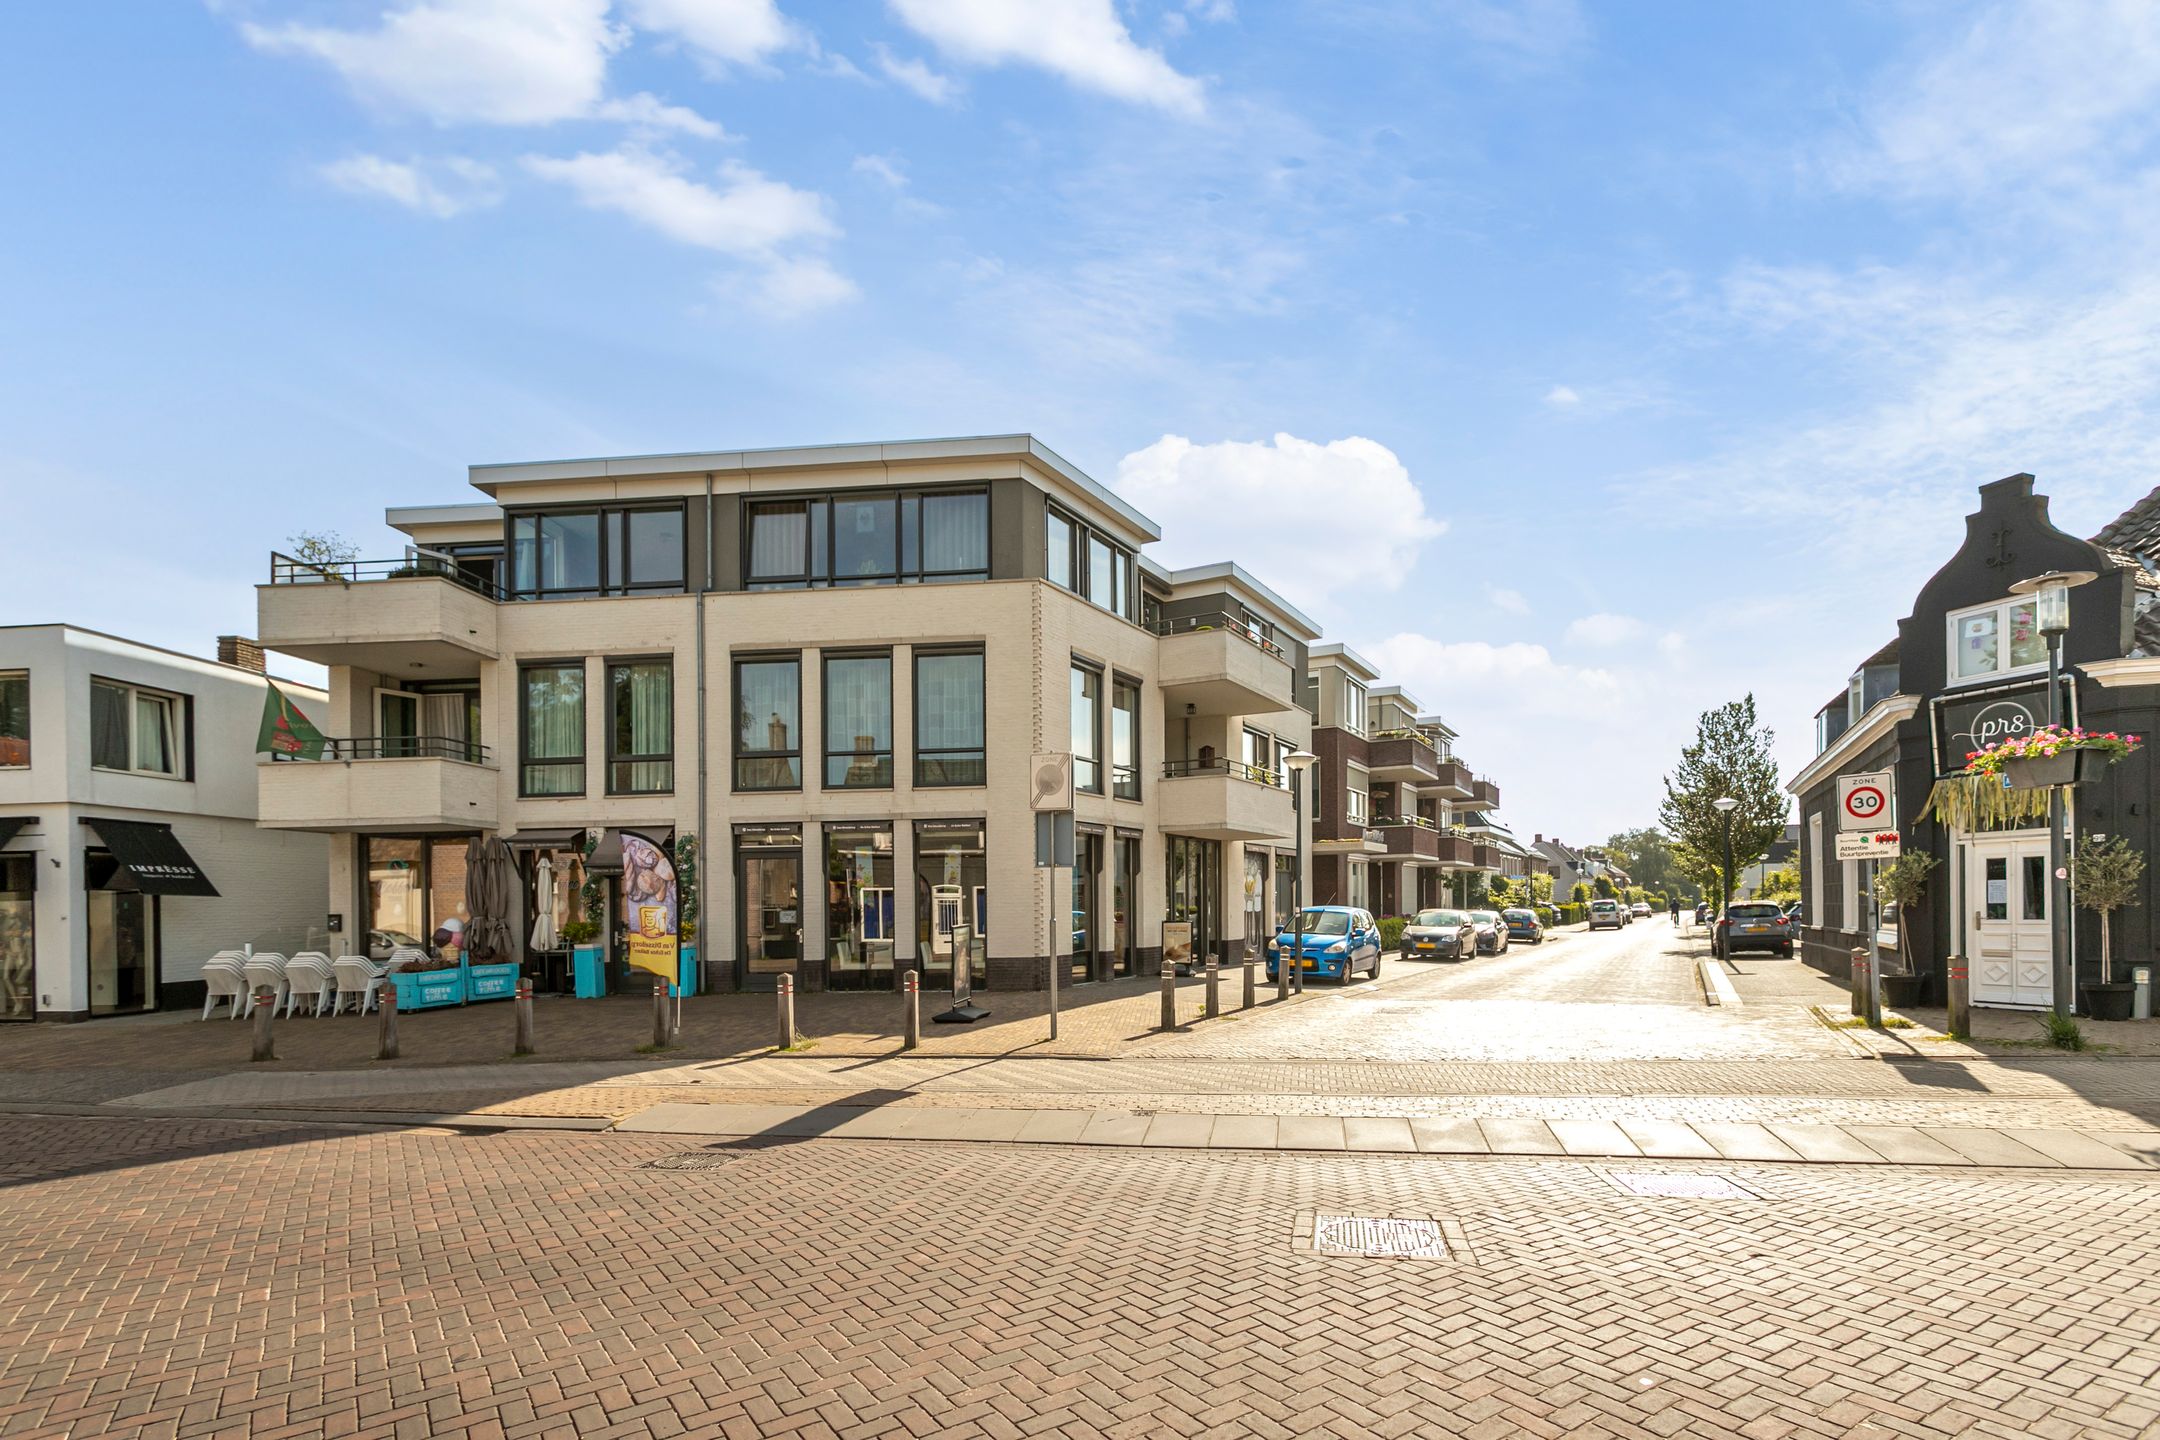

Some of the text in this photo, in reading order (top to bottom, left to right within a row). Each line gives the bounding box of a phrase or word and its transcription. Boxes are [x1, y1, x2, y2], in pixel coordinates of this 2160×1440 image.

[1980, 714, 2024, 744] pr8
[1852, 777, 1877, 785] ZONE
[1853, 796, 1878, 809] 30
[1839, 850, 1889, 858] Buurtpreventie
